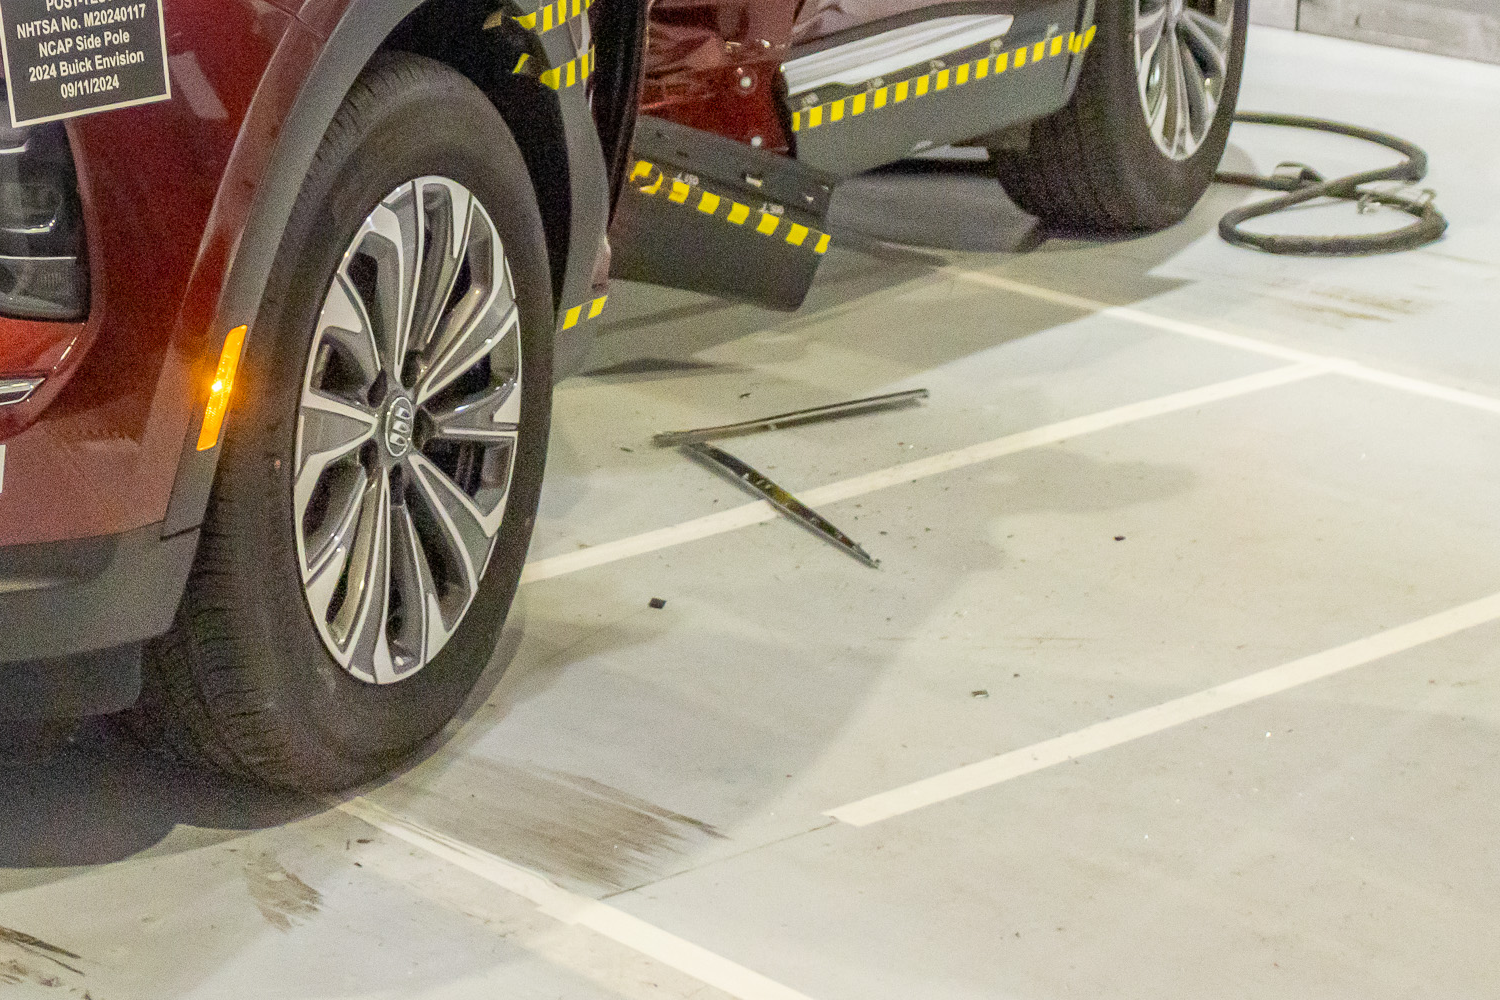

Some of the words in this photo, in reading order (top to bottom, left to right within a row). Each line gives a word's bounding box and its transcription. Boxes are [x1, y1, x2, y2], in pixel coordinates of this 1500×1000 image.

[16, 19, 60, 40] NHTSA
[62, 16, 81, 32] No.
[83, 3, 146, 28] M20240117
[38, 37, 73, 58] NCAP
[76, 33, 102, 52] Side
[104, 28, 130, 47] Pole
[29, 63, 57, 82] 2024
[59, 57, 93, 77] Buick
[94, 50, 145, 70] Envision
[60, 74, 120, 99] 09/11/2024
